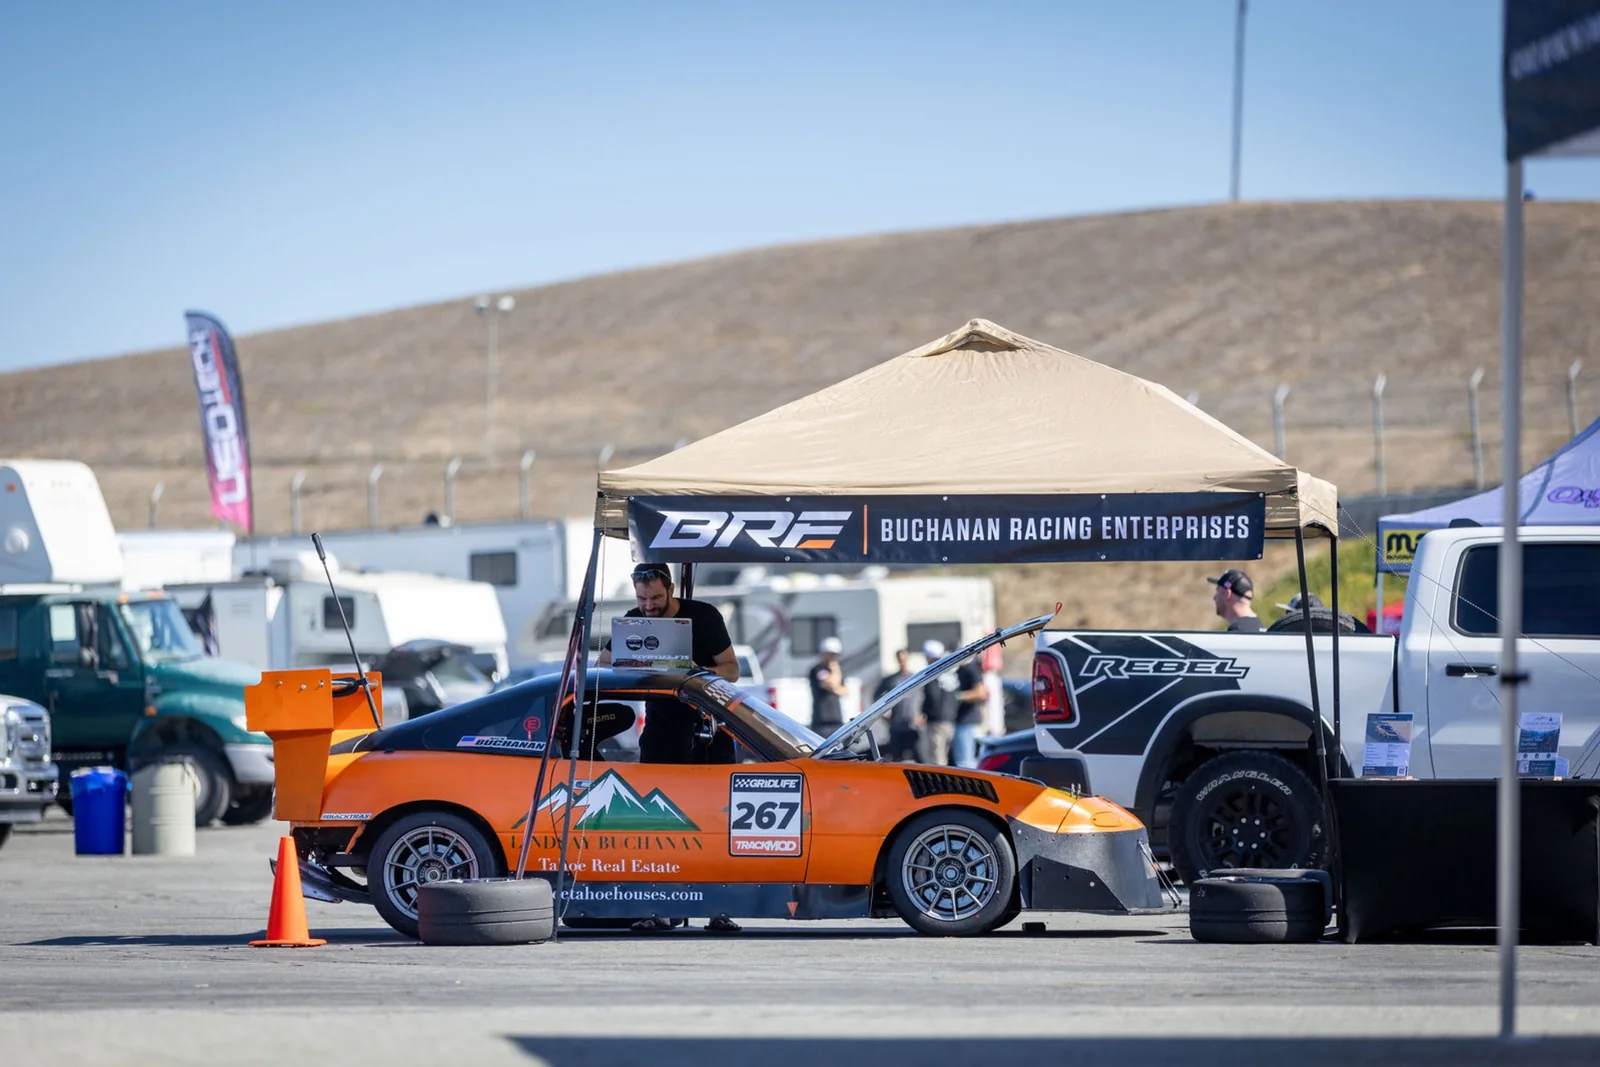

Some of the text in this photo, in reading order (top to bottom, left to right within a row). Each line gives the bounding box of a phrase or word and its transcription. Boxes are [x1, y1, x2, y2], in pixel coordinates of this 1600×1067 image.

[649, 510, 853, 549] BRE
[880, 515, 1250, 542] BUCHANAN RACING ENTERPRISES
[1079, 655, 1251, 679] REBEL
[475, 738, 546, 751] BUCHANAN
[749, 779, 799, 789] GRIDLIFE
[1196, 770, 1293, 801] WRANGLER
[731, 801, 800, 830] 267
[600, 835, 704, 851] BUCHANAN
[735, 840, 797, 852] TRACKMOD
[591, 858, 626, 873] Real
[631, 859, 681, 874] Estate
